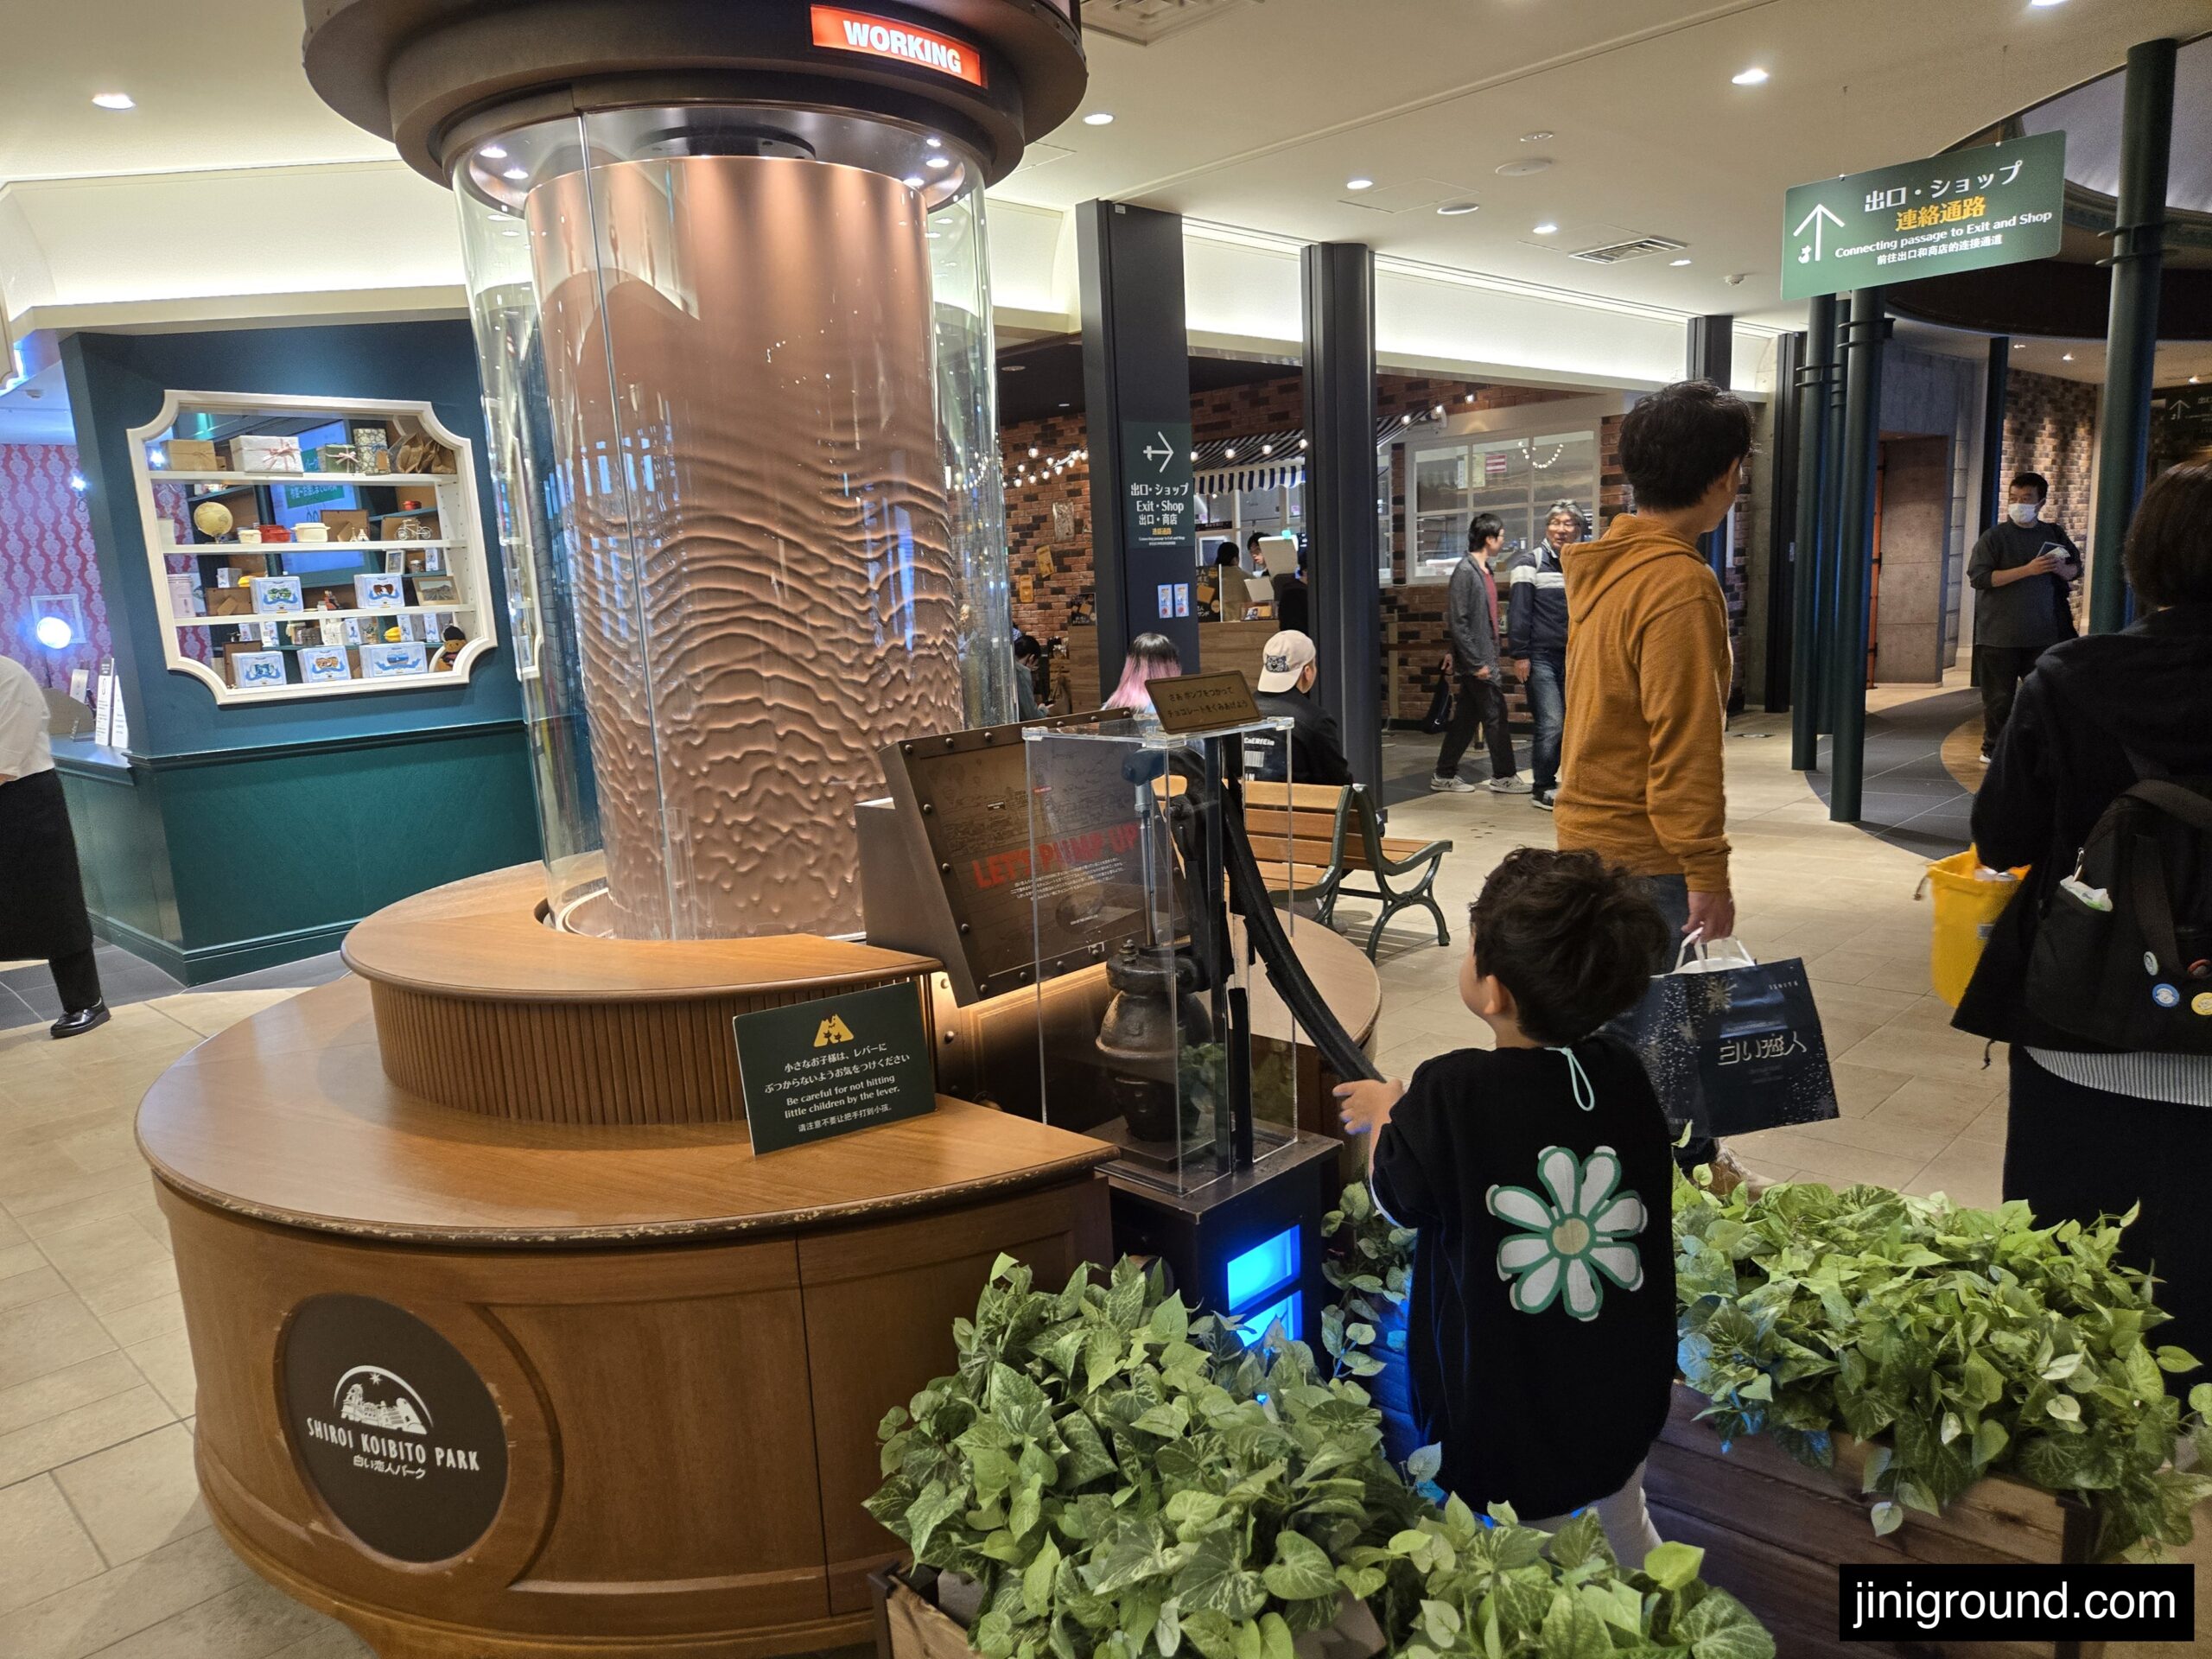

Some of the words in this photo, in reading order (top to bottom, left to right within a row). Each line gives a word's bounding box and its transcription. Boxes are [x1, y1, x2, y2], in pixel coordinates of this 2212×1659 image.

[842, 20, 962, 73] WORKING
[1865, 159, 2024, 213] 出口・ショップ
[1895, 195, 1986, 232] 連絡通路
[1834, 239, 1897, 258] Connecting
[1900, 231, 1948, 249] passage
[1950, 226, 1964, 238] to
[1967, 222, 1991, 235] Exit
[1993, 217, 2017, 230] and
[2019, 212, 2053, 226] Shop
[1130, 482, 1189, 496] 出口・ショップ
[1136, 500, 1154, 512] Exit
[1160, 499, 1185, 514] Shop
[1139, 513, 1178, 525] 出口・商店
[1039, 831, 1104, 871] PUMP
[1108, 822, 1140, 855] UP
[765, 1054, 911, 1094] ぶつからないようお気をつけください
[784, 1043, 887, 1073] 小さなお子様は、レバーに
[785, 1107, 807, 1119] little
[809, 1098, 845, 1113] children
[847, 1094, 858, 1104] by
[860, 1090, 874, 1101] the
[876, 1086, 900, 1097] lever.
[786, 1096, 798, 1106] Be
[800, 1089, 833, 1103] careful
[834, 1085, 849, 1096] for
[849, 1082, 864, 1091] not
[866, 1075, 895, 1088] hitting
[307, 1417, 353, 1449] SHIROI
[360, 1433, 426, 1464] KOIBITO
[435, 1446, 480, 1471] PARK
[353, 1454, 426, 1479] 白い恋人パーク
